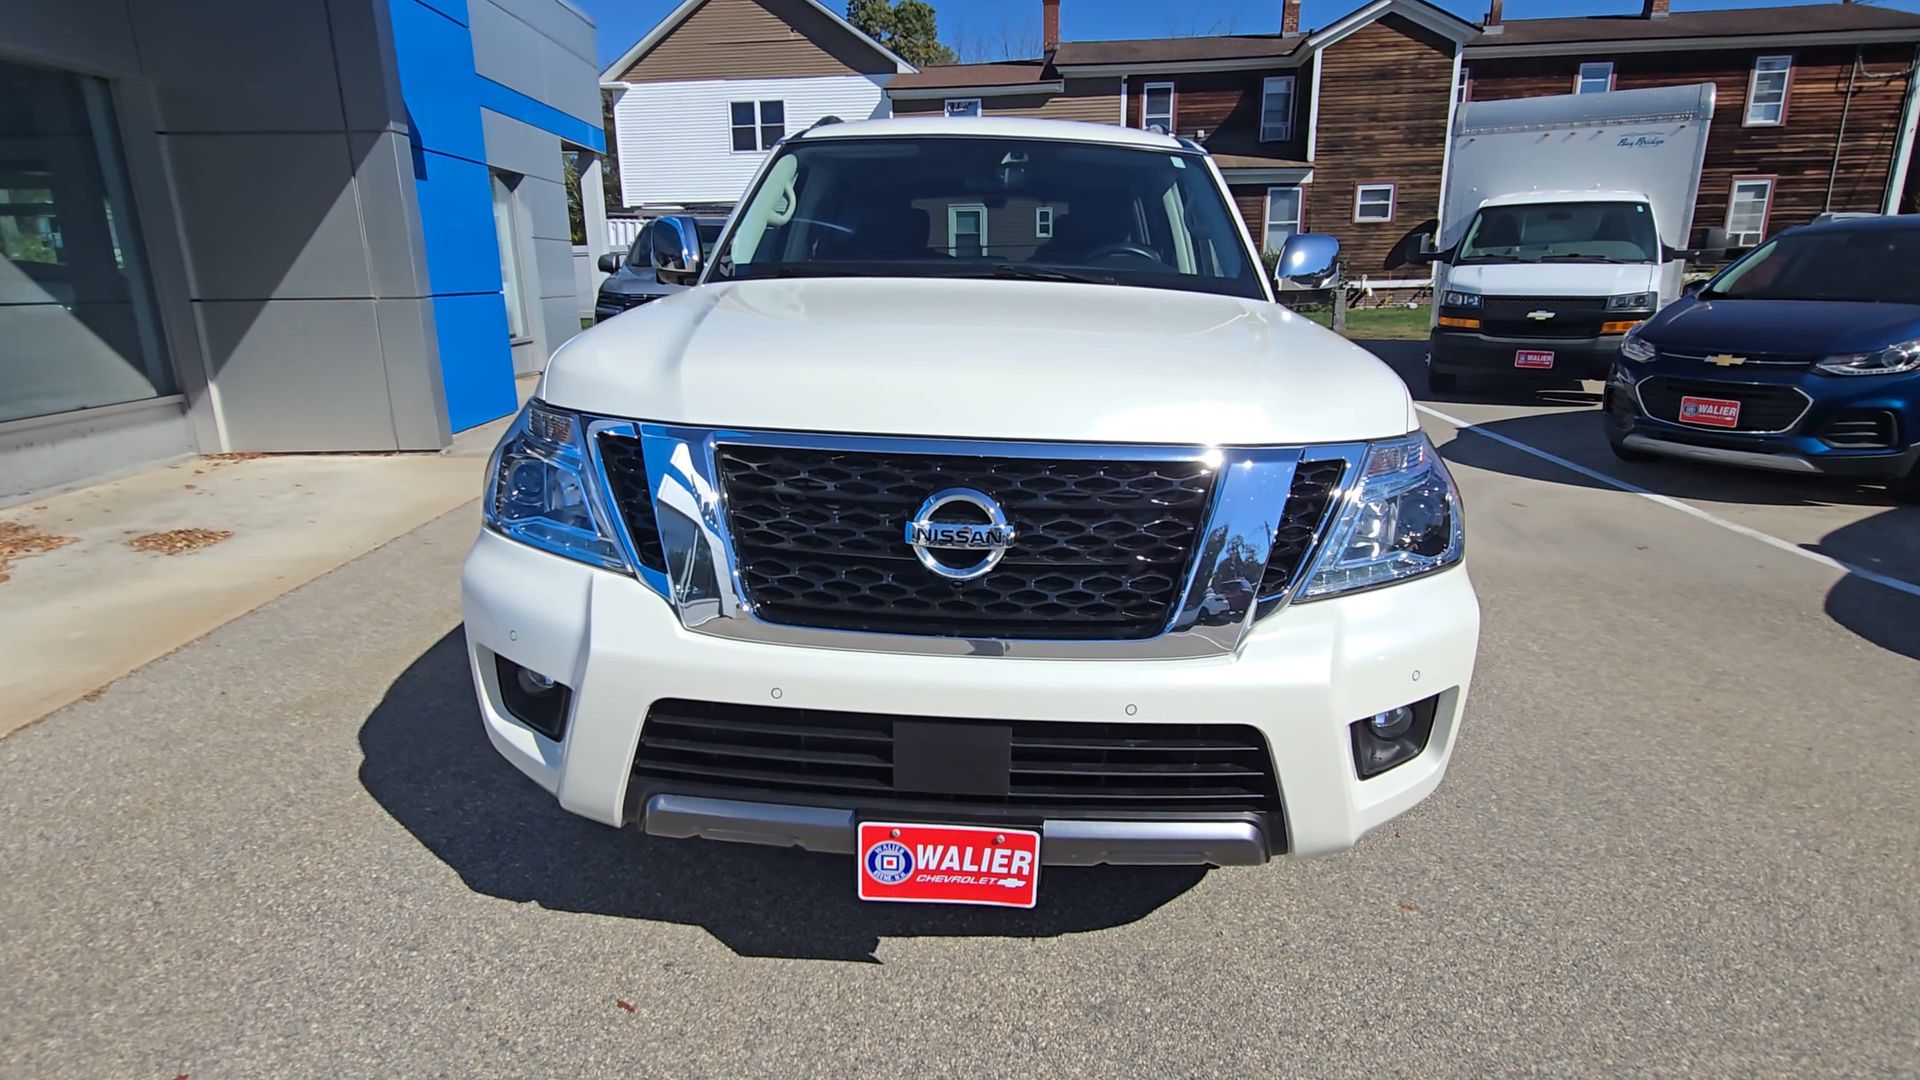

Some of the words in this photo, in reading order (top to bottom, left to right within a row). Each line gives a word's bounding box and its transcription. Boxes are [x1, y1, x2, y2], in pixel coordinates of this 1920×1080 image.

[1617, 137, 1633, 148] Bay
[1635, 137, 1664, 148] Bridge
[1698, 404, 1736, 417] WALIER
[917, 528, 1002, 544] NISSAN
[874, 843, 906, 854] WALIER
[916, 844, 1033, 876] WALIER
[916, 874, 996, 886] CHEVROLET
